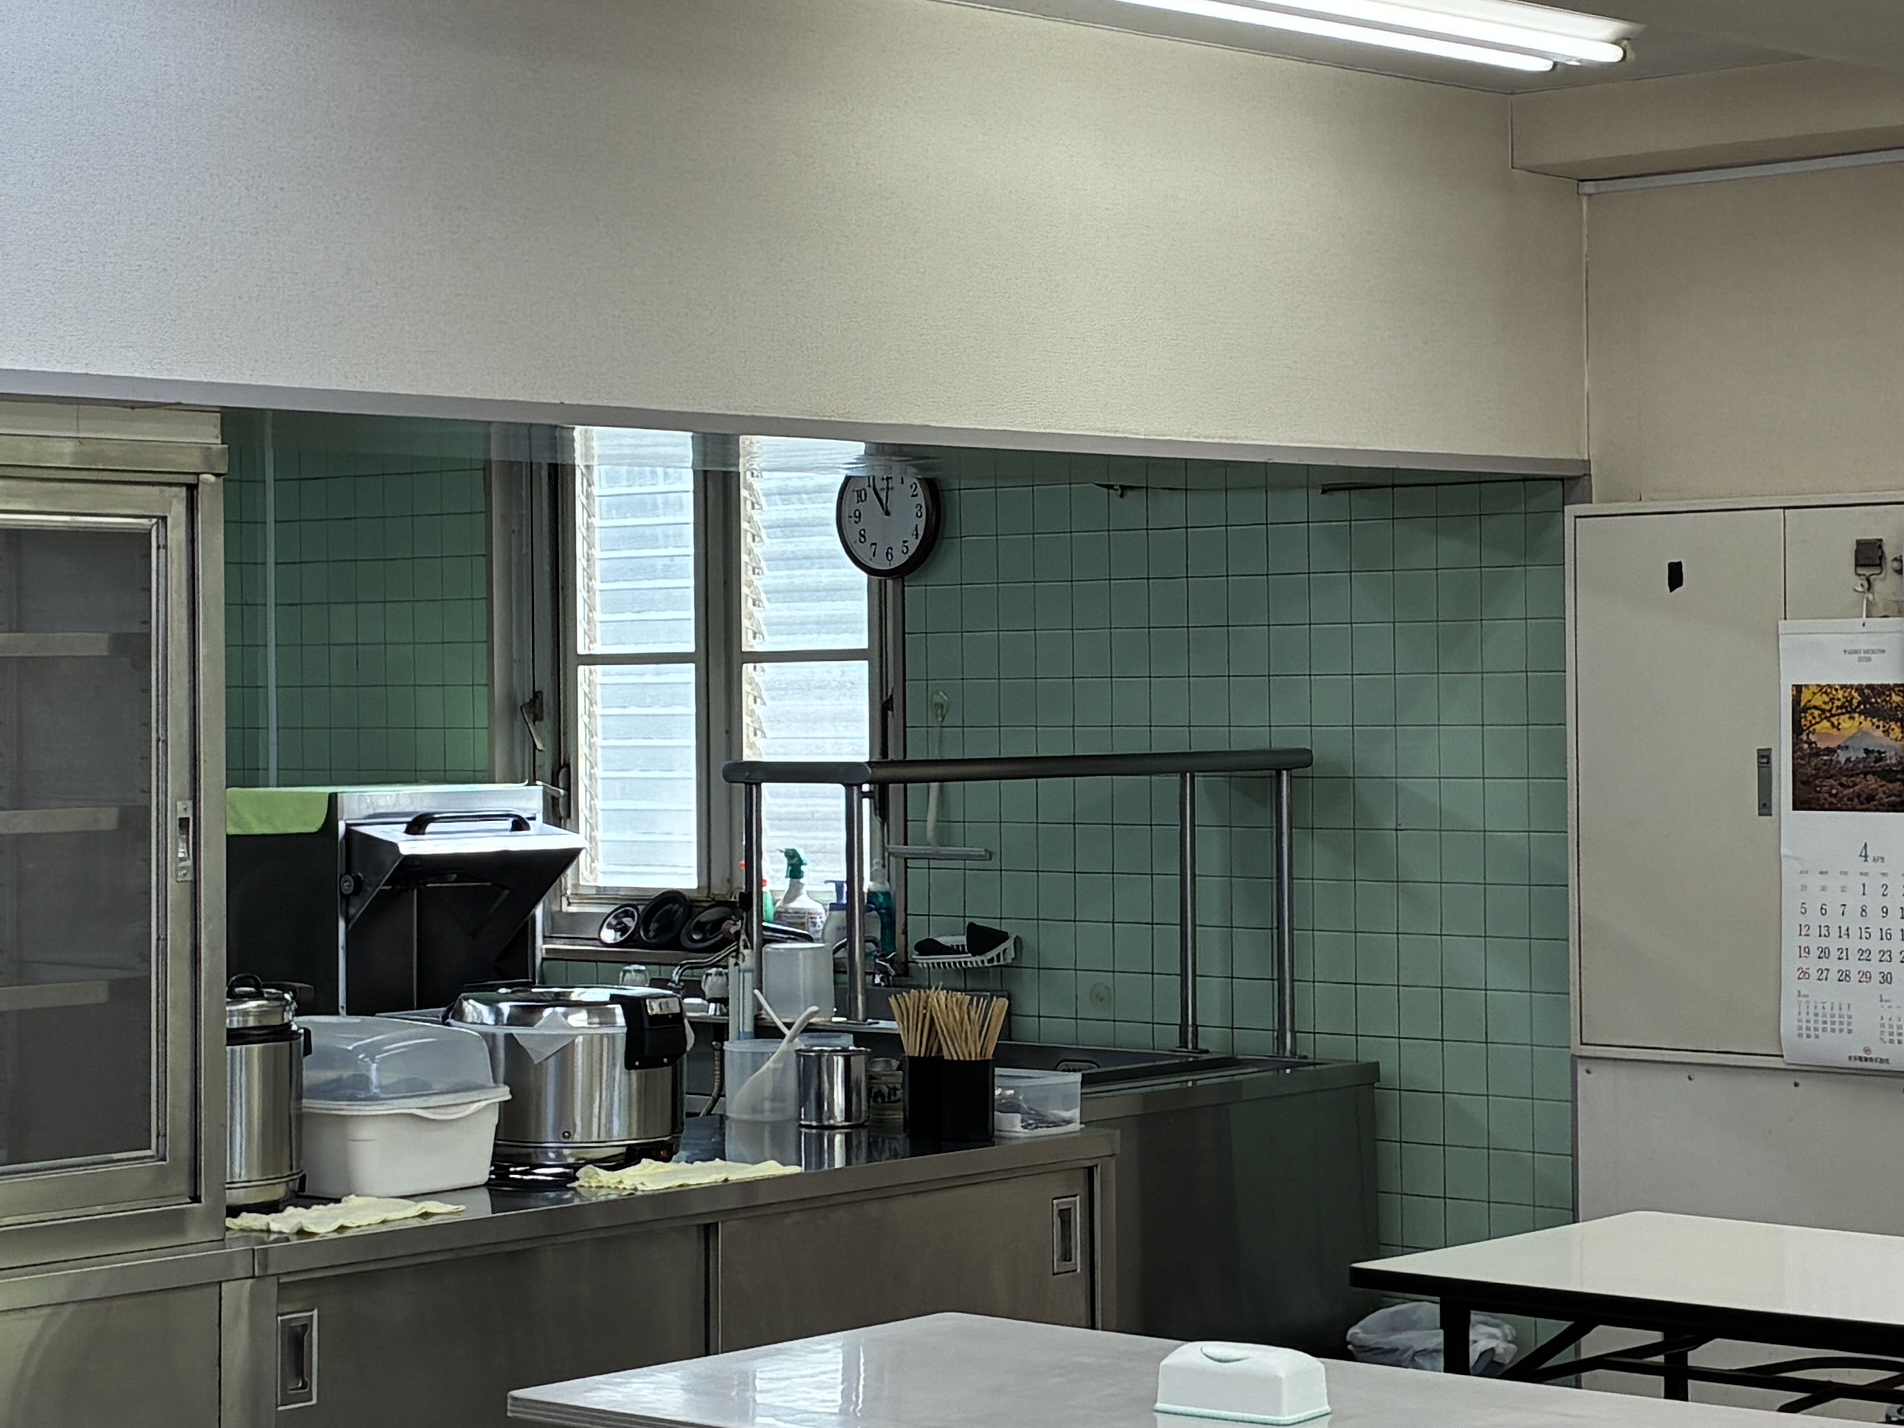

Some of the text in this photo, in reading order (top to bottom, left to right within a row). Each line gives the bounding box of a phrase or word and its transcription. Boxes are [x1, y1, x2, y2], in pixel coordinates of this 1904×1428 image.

[856, 488, 867, 504] 10
[910, 482, 918, 497] 2
[853, 509, 862, 524] 9
[916, 504, 923, 518] 3
[859, 529, 867, 544] 8
[912, 524, 919, 539] 4
[870, 542, 877, 557] 7
[885, 547, 894, 562] 6
[902, 540, 909, 555] 5
[1859, 842, 1868, 862] 4
[1861, 883, 1866, 896] 1
[1881, 884, 1888, 896] 2
[1800, 902, 1807, 915] 5
[1819, 904, 1827, 916] 6
[1840, 904, 1846, 916] 7
[1859, 905, 1867, 917] 8
[1880, 906, 1888, 918] 9
[1798, 924, 1810, 936] 12
[1818, 925, 1830, 937] 13
[1838, 926, 1849, 938] 14
[1858, 927, 1871, 940] 15
[1879, 928, 1892, 940] 16
[1798, 946, 1810, 958] 19
[1816, 947, 1830, 959] 20
[1836, 948, 1848, 960] 21
[1857, 948, 1871, 961] 22
[1878, 950, 1892, 962] 23
[1796, 967, 1810, 980] 26
[1816, 968, 1830, 981] 27
[1837, 970, 1851, 982] 28
[1857, 971, 1871, 983] 29
[1878, 972, 1892, 984] 30
